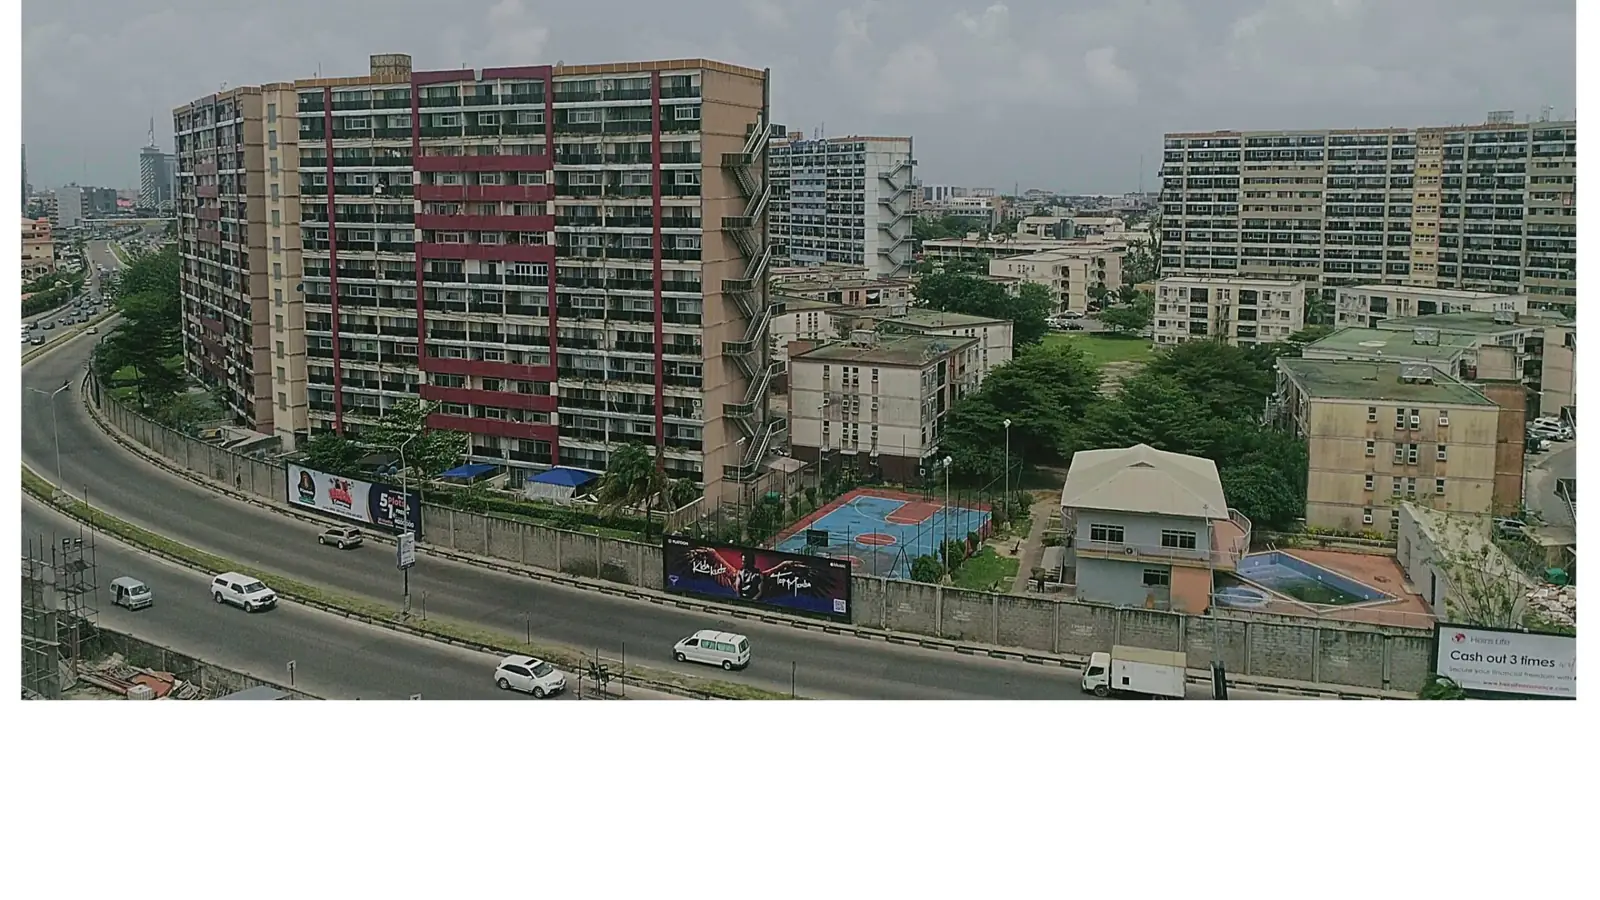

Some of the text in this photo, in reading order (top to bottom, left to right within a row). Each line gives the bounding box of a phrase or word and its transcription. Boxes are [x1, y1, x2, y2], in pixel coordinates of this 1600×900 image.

[380, 492, 388, 507] 5
[388, 504, 394, 519] 1
[1450, 650, 1483, 663] Cash
[1486, 654, 1507, 664] out
[1509, 655, 1517, 665] 3
[1520, 655, 1556, 668] times
